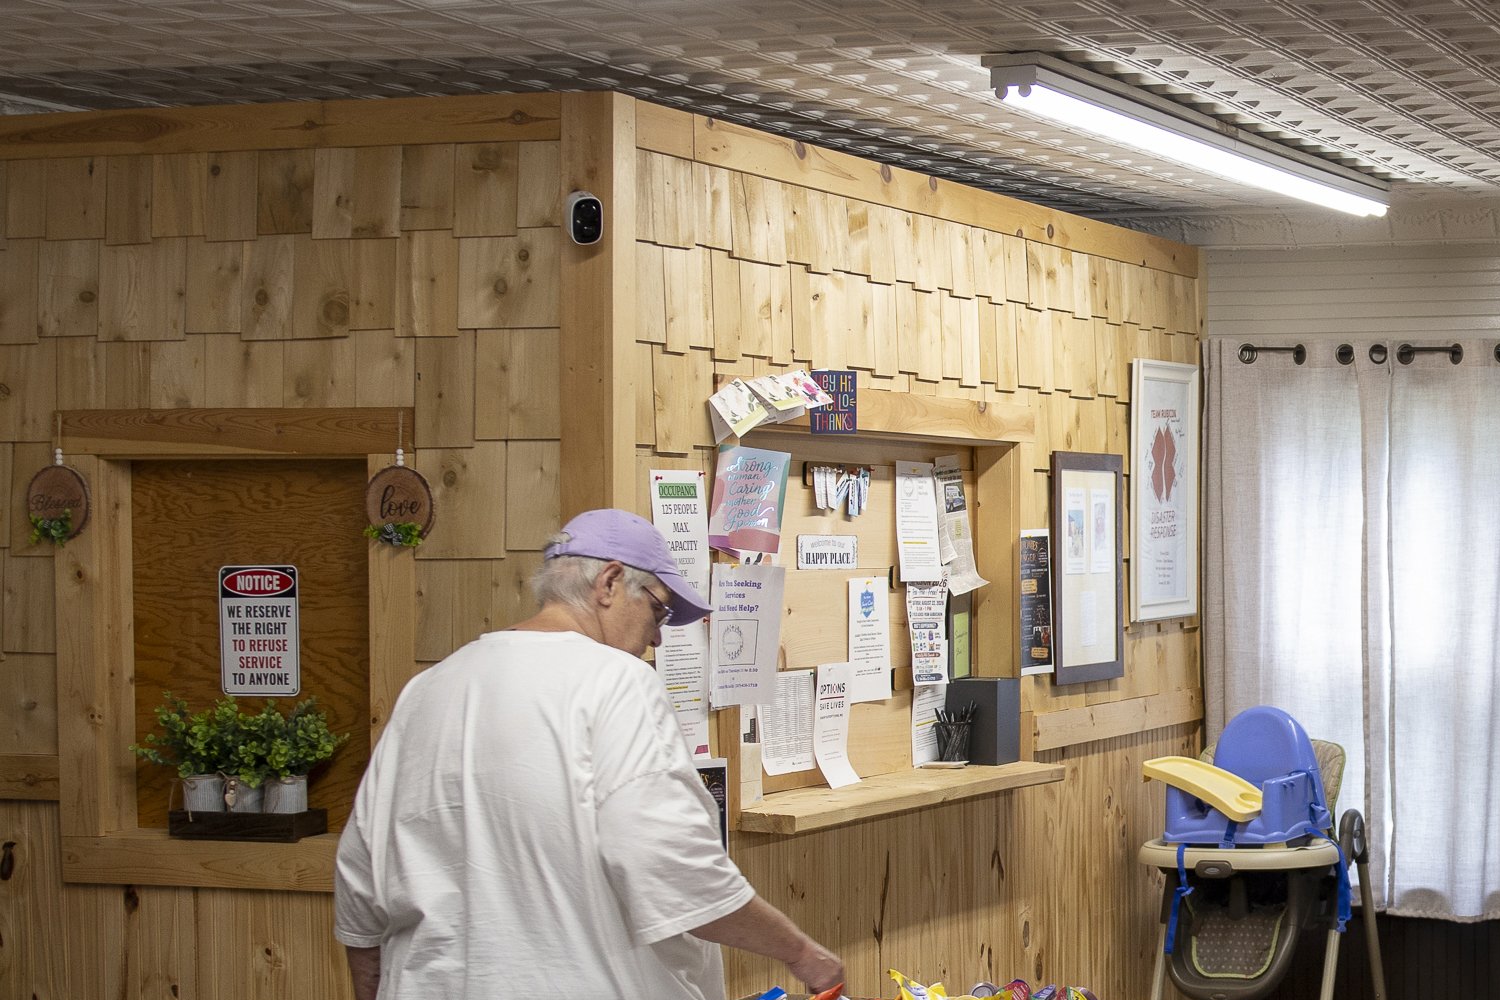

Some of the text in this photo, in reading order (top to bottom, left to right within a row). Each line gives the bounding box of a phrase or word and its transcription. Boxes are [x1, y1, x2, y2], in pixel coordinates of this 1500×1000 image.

[814, 413, 853, 431] THANKS
[659, 485, 698, 497] OCCUPANCY
[729, 480, 776, 501] Caring
[381, 485, 421, 519] love
[662, 504, 698, 515] 125 PEOPLE
[667, 540, 698, 551] APACITY
[806, 553, 850, 564] HAPPY PLACE
[236, 575, 280, 591] NOTICE
[734, 580, 762, 589] Seeking
[227, 606, 291, 618] WE RESERVE
[738, 604, 759, 613] Help?
[232, 622, 287, 634] THE RIGHT
[232, 639, 288, 652] TO REFUSE
[239, 656, 282, 668] SERVICE
[232, 673, 289, 685] TO ANYONE
[820, 682, 845, 695] OPTIONS
